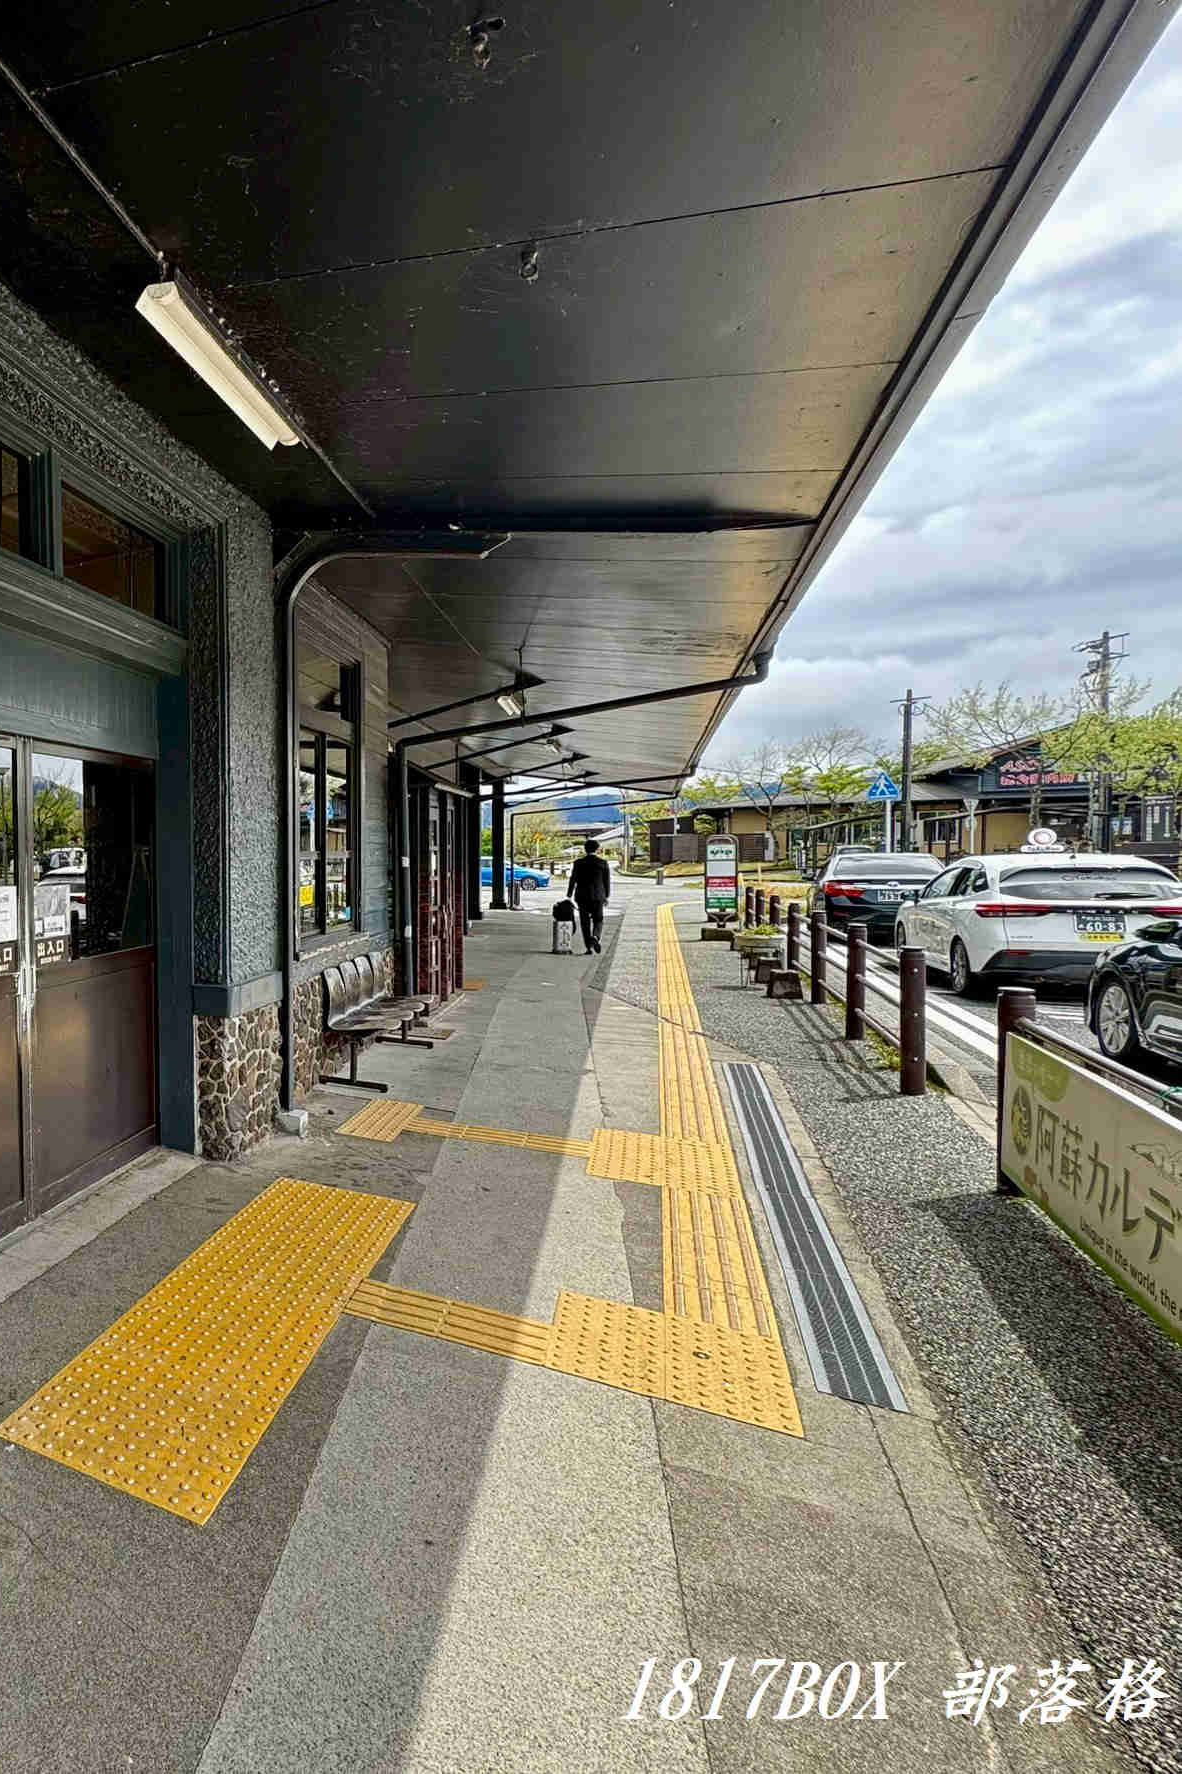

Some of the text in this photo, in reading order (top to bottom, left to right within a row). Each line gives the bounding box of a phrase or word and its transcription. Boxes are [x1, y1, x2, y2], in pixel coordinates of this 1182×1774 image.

[37, 940, 64, 957] 出入口
[1115, 1248, 1129, 1272] the
[1130, 1263, 1159, 1301] world,
[1160, 1286, 1177, 1316] the
